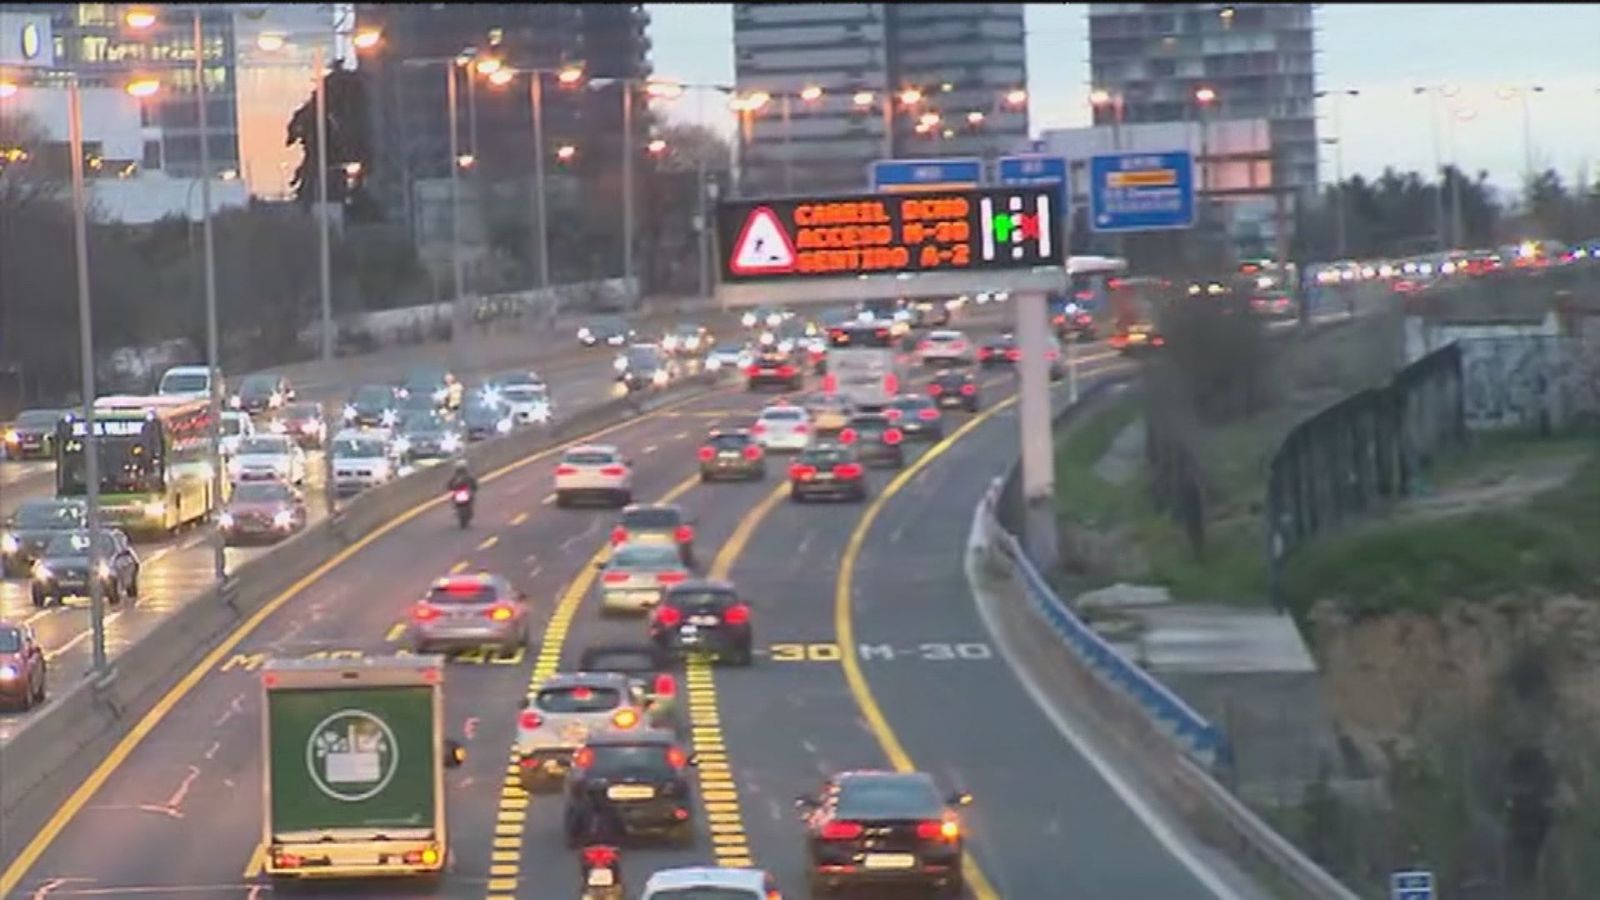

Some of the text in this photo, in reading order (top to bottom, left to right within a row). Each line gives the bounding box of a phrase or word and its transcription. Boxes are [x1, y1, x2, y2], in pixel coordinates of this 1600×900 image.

[795, 202, 891, 225] CARRIL
[796, 225, 893, 248] ACCESO
[797, 244, 970, 273] SENTIDO A-2
[858, 643, 992, 661] M-30
